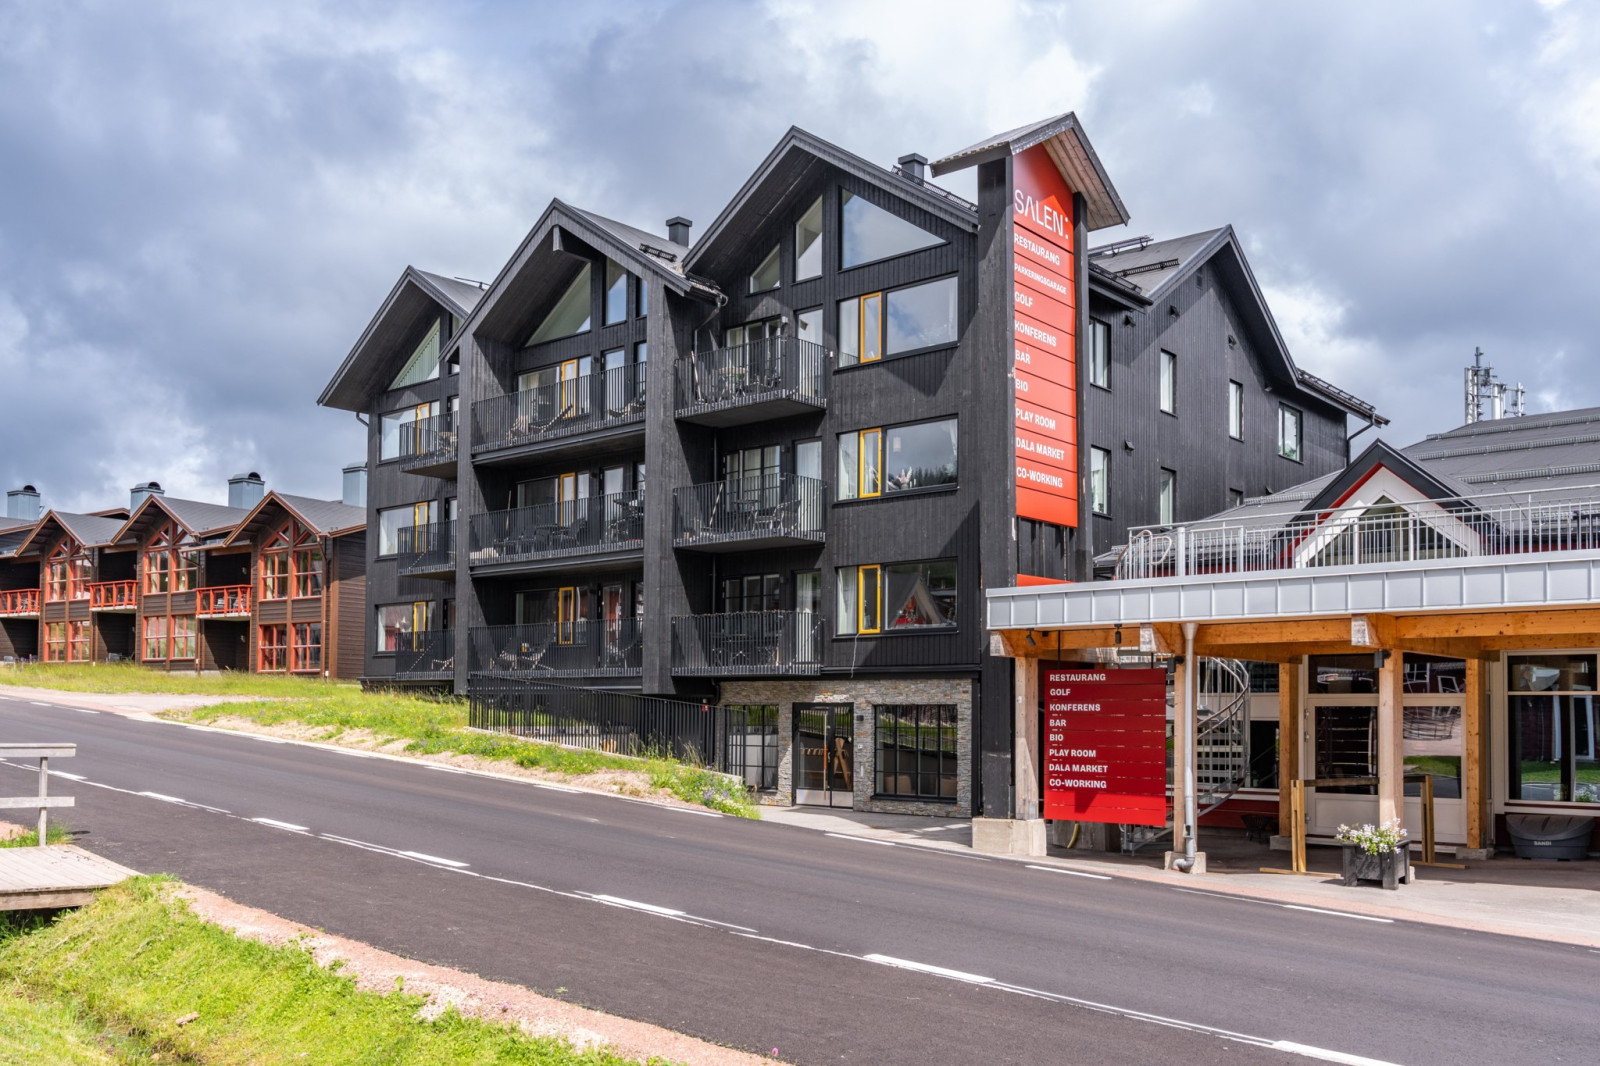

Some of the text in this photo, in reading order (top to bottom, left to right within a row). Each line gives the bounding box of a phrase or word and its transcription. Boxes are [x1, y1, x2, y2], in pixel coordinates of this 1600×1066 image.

[1014, 233, 1060, 266] RESTAURANG
[1014, 263, 1067, 295] PARKERINGSGARAGE
[1015, 291, 1033, 308] GOLF
[1015, 320, 1057, 347] KONFERENS
[1015, 349, 1031, 365] BAR
[1015, 378, 1028, 392] BIO
[1015, 408, 1056, 430] PLAY ROOM
[1015, 437, 1065, 461] DALA MARKET
[1016, 467, 1063, 488] CO-WORKING
[1049, 673, 1106, 682] RESTAURANG
[1049, 688, 1071, 696] GOLF
[1049, 703, 1101, 712] KONFERENS
[1049, 719, 1067, 727] BAR
[1049, 733, 1064, 742] BIO
[1049, 748, 1096, 758] PLAY ROOM
[1049, 763, 1108, 773] DALA MARKET
[1049, 778, 1107, 789] CO-WORKING
